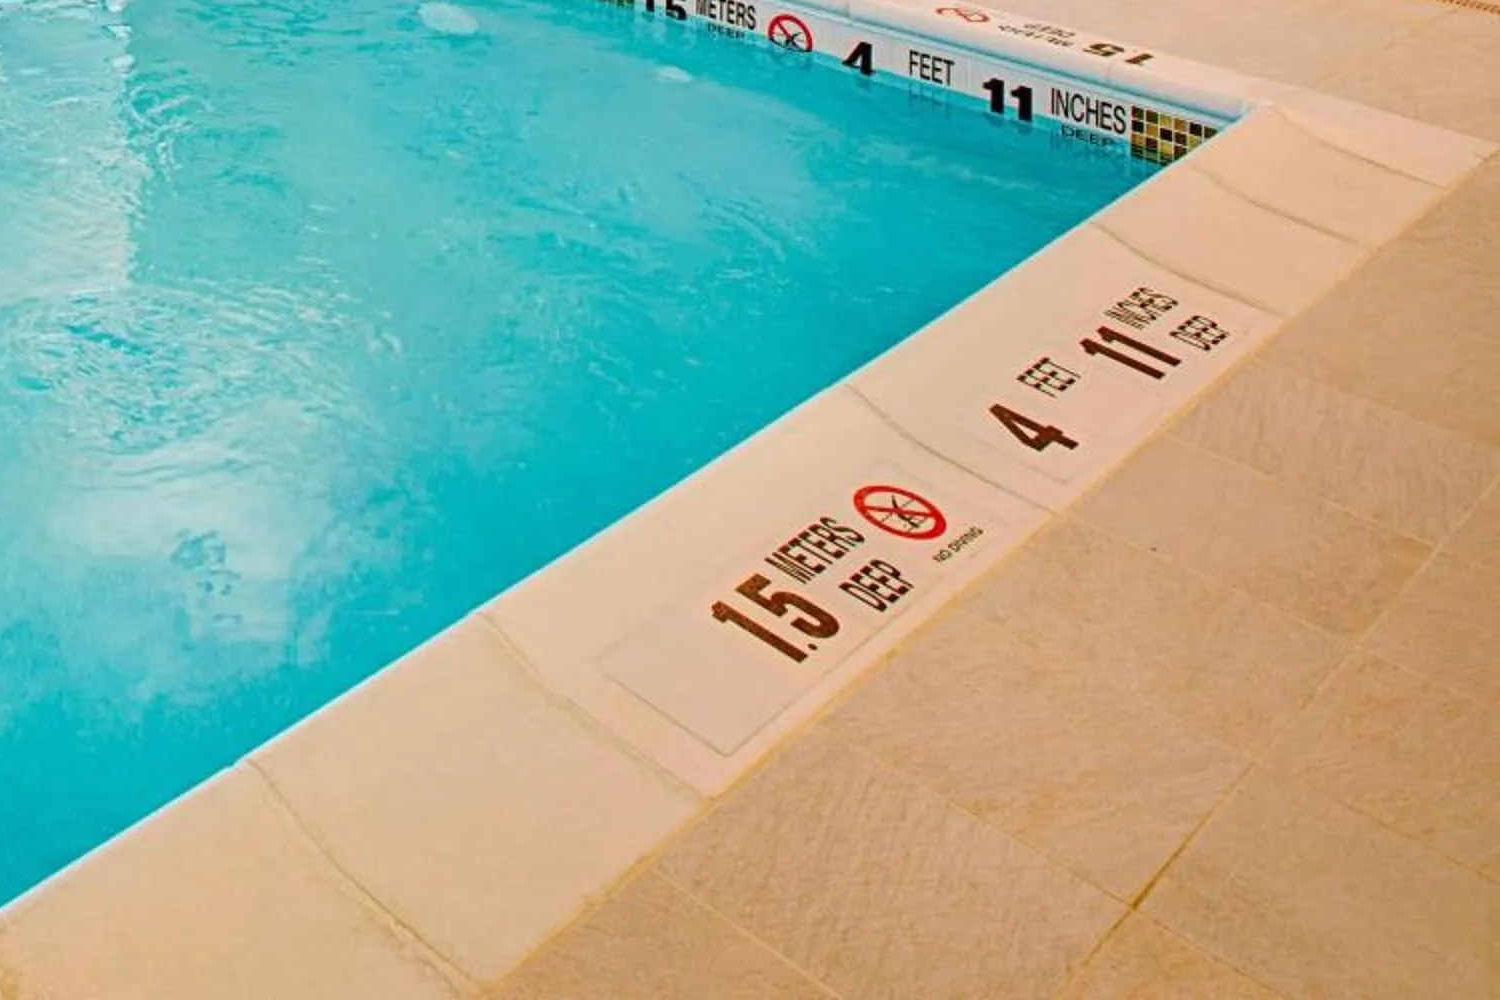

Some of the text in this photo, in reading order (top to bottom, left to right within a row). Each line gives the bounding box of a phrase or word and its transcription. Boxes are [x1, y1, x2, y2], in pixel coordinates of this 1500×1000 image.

[842, 41, 876, 77] 4
[909, 50, 954, 87] FEET
[983, 78, 1032, 123] 11
[1051, 88, 1126, 135] INCHES
[1169, 315, 1231, 351] DEEP
[989, 286, 1183, 452] 4 FEET 11 INCHES
[764, 517, 865, 584] METERS
[932, 549, 952, 564] NO
[838, 559, 914, 612] DEEP
